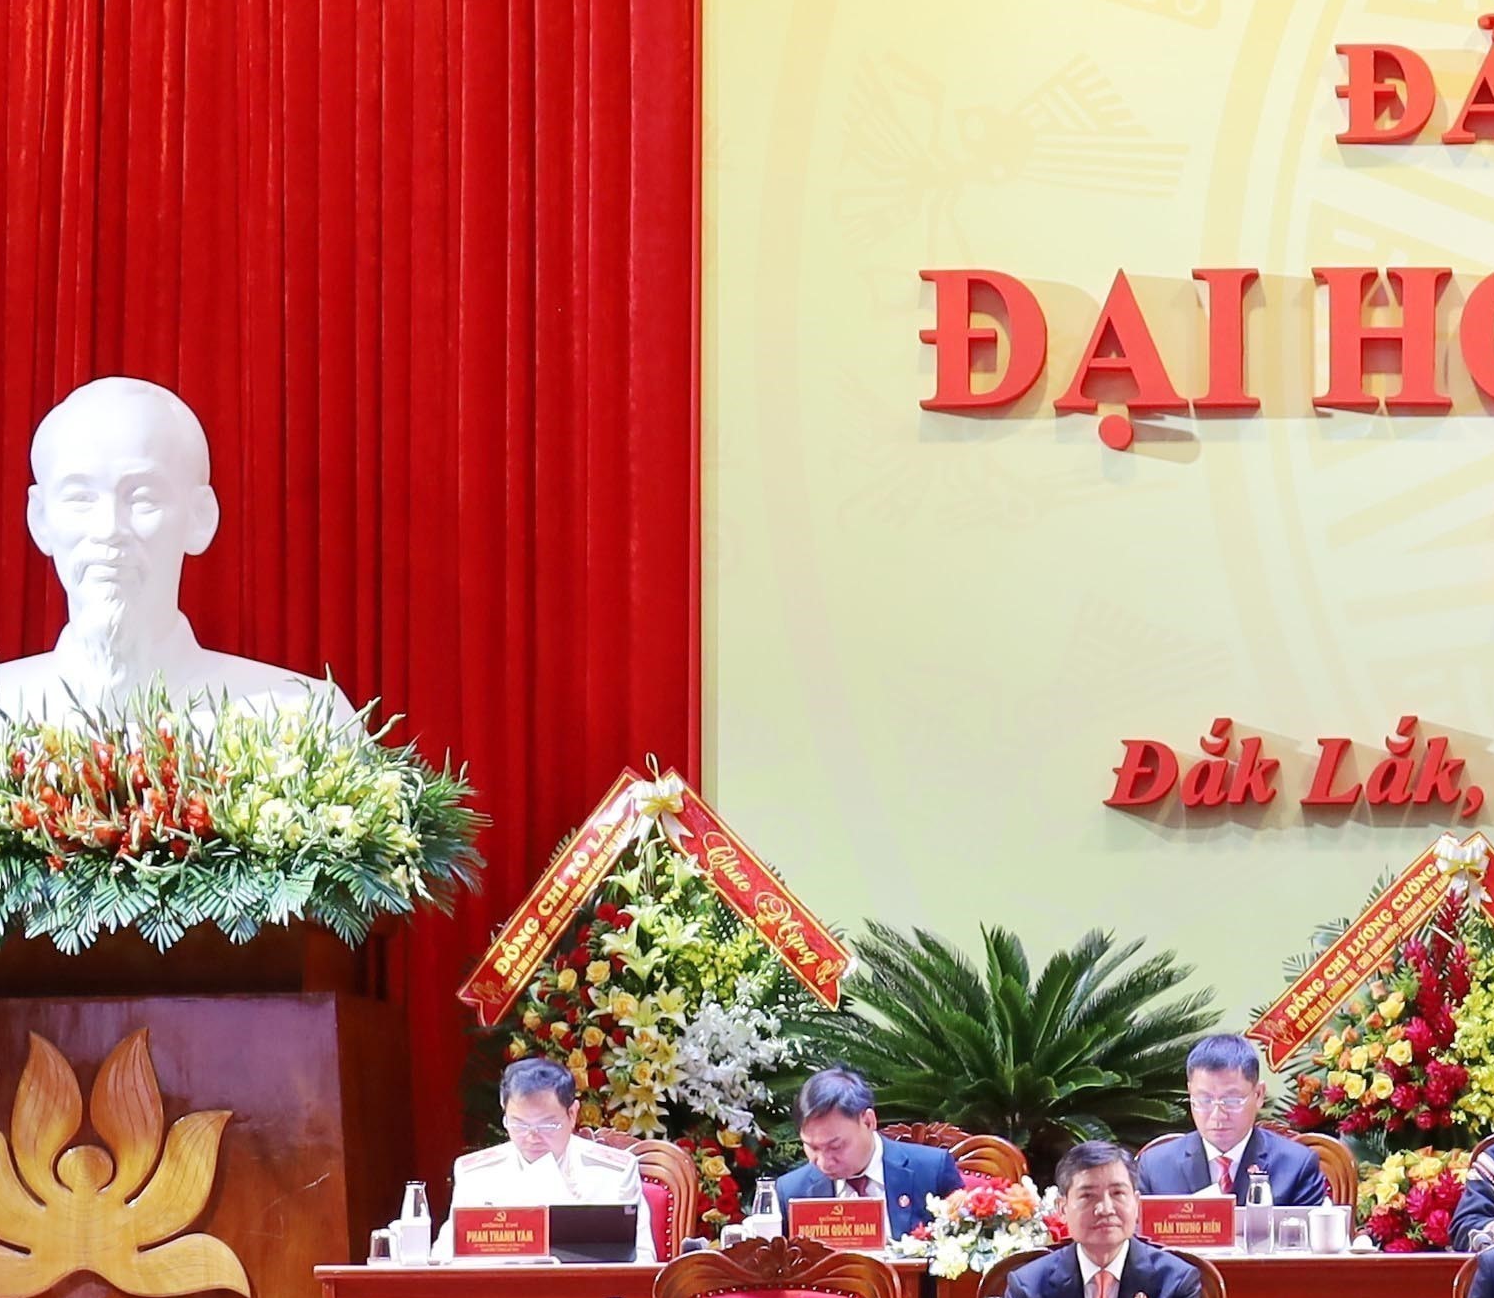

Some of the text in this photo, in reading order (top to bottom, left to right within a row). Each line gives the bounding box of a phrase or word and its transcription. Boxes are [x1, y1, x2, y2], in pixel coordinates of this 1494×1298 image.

[920, 269, 1260, 451] ĐẠI
[1105, 718, 1280, 811] Đắk
[1301, 717, 1484, 819] Lắk,
[489, 912, 542, 976] ĐỒNG
[534, 875, 569, 918] CHÍ
[1282, 973, 1326, 1020] ĐỒNG
[1320, 948, 1350, 981] CHÍ
